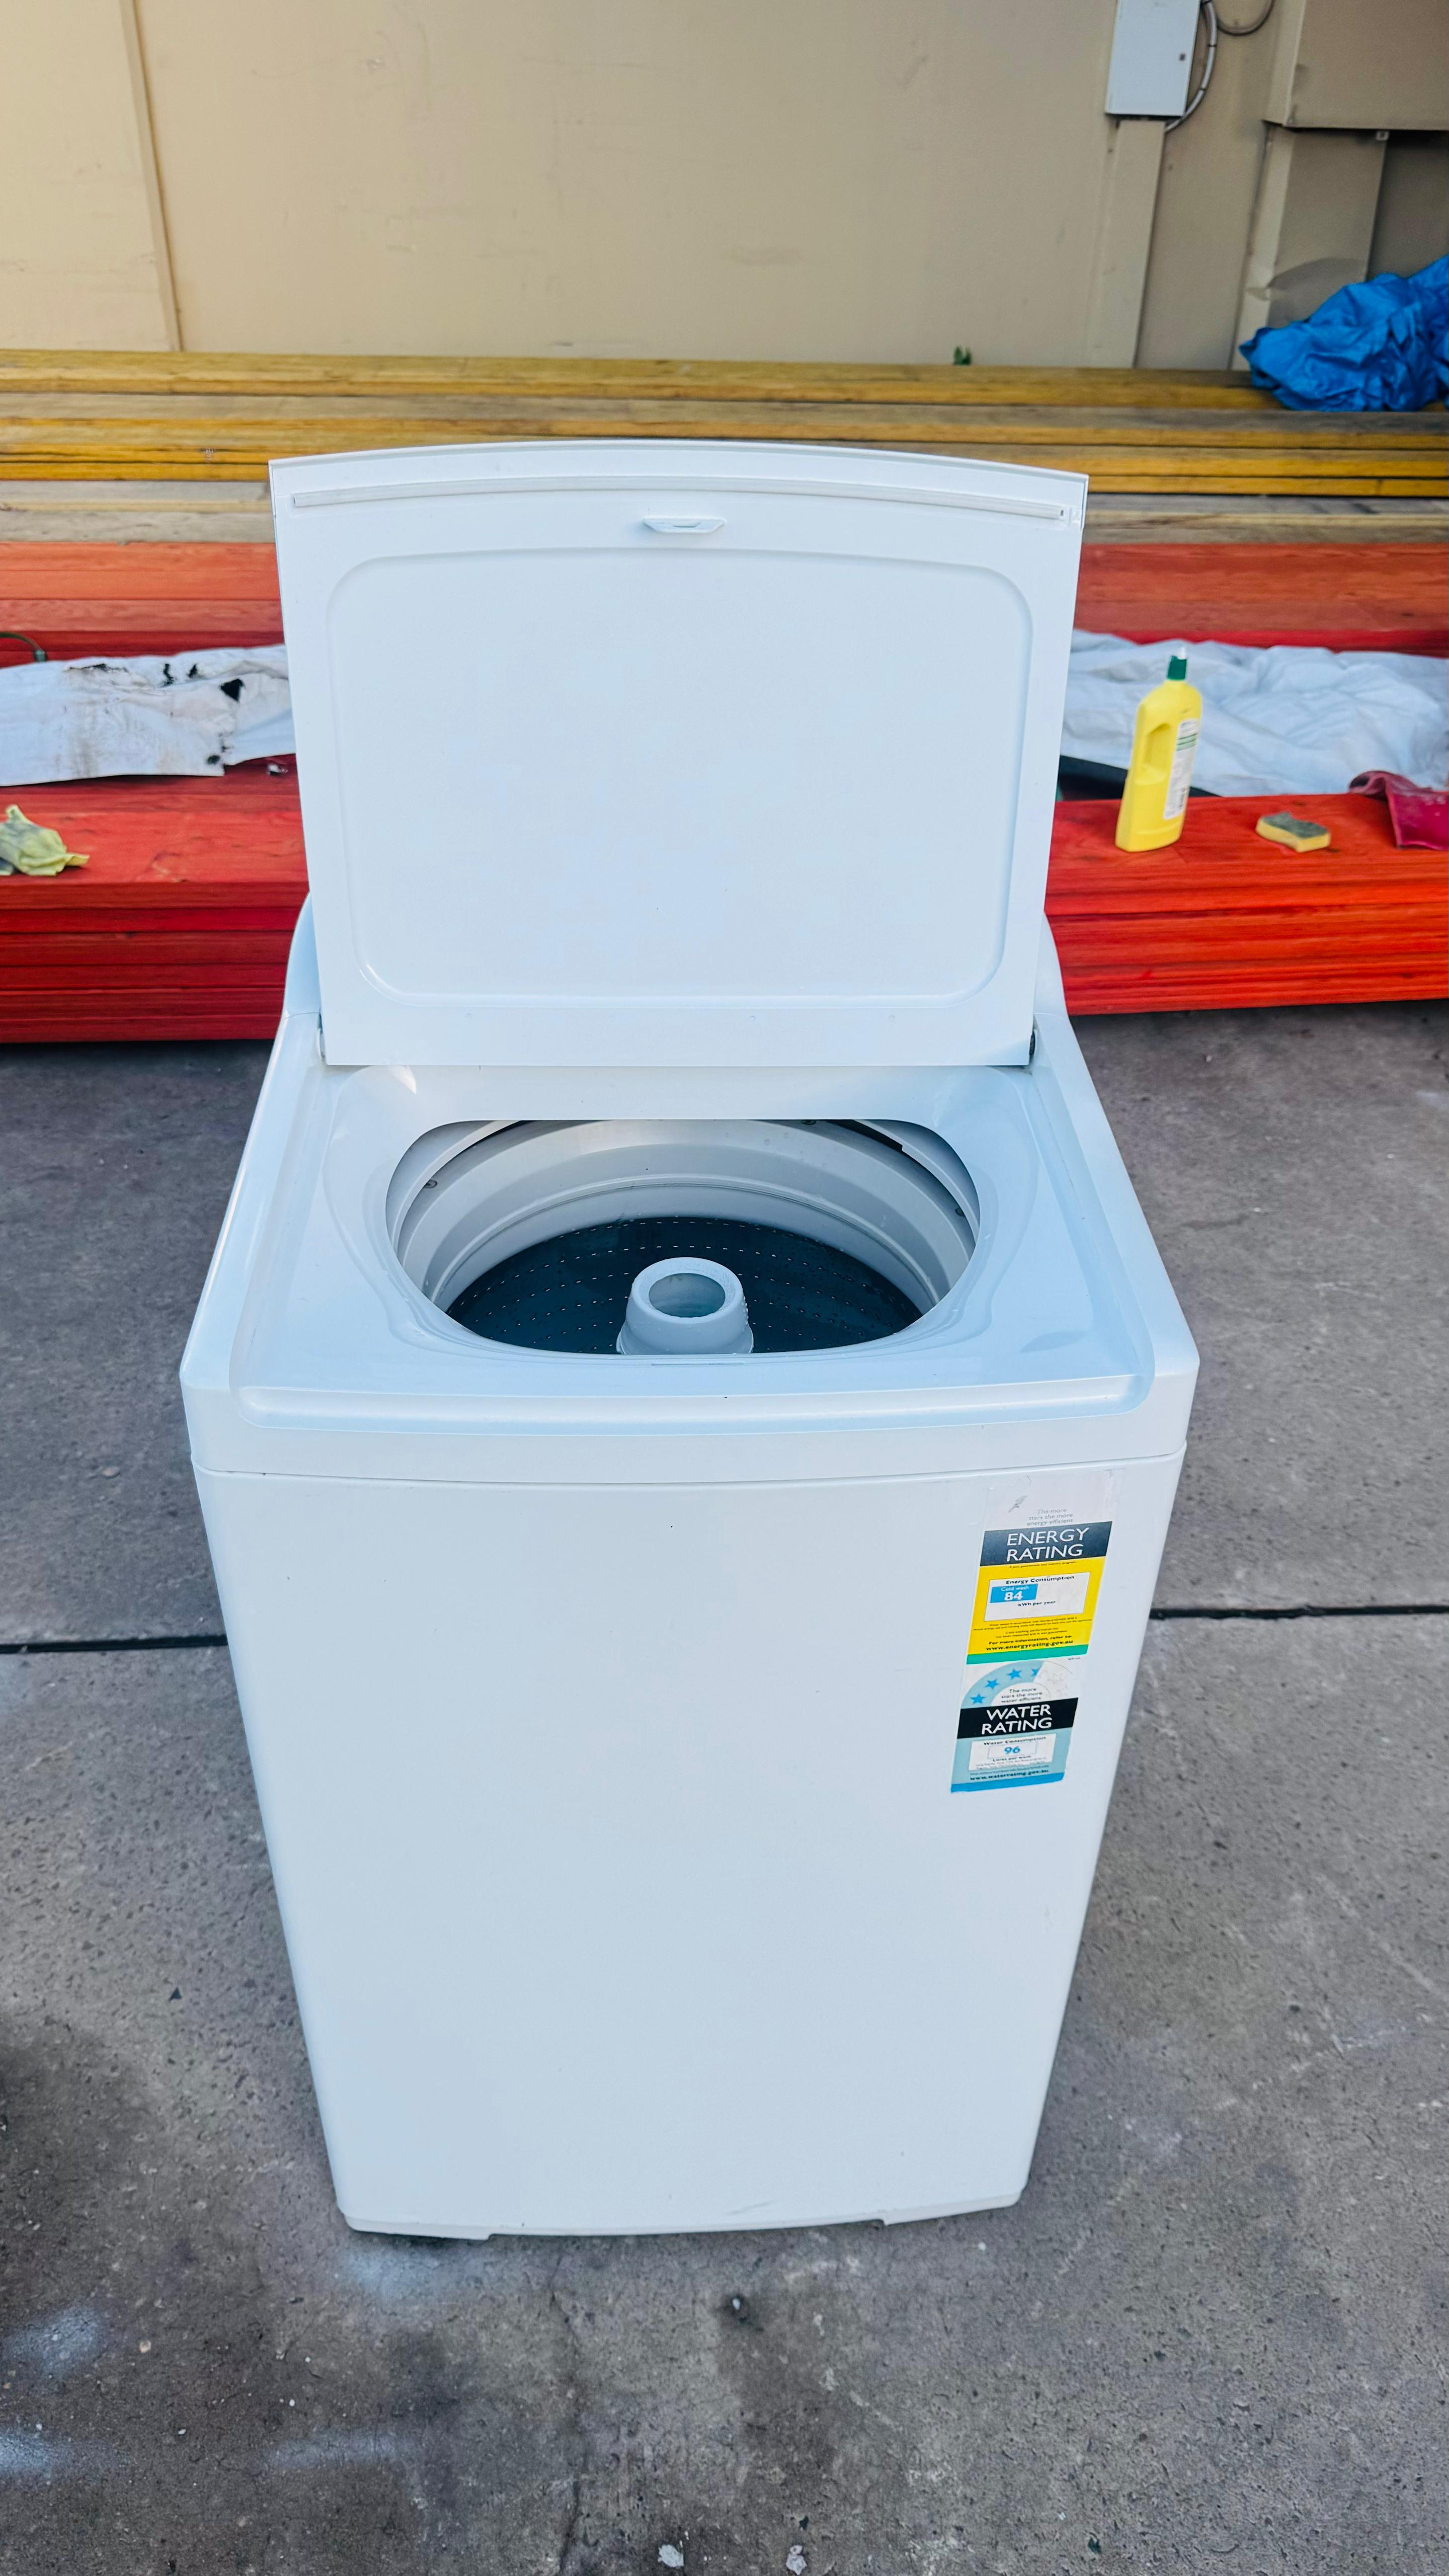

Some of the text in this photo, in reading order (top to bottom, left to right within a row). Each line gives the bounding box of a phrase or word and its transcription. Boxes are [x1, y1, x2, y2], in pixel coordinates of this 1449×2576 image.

[1007, 1527, 1090, 1546] ENERGY
[1007, 1544, 1083, 1562] RATING
[1004, 1590, 1023, 1601] 84
[986, 1640, 1073, 1651] www.energyrating.gov.au
[986, 1704, 1052, 1721] WATER
[982, 1717, 1053, 1735] RATING
[1004, 1746, 1020, 1754] 96
